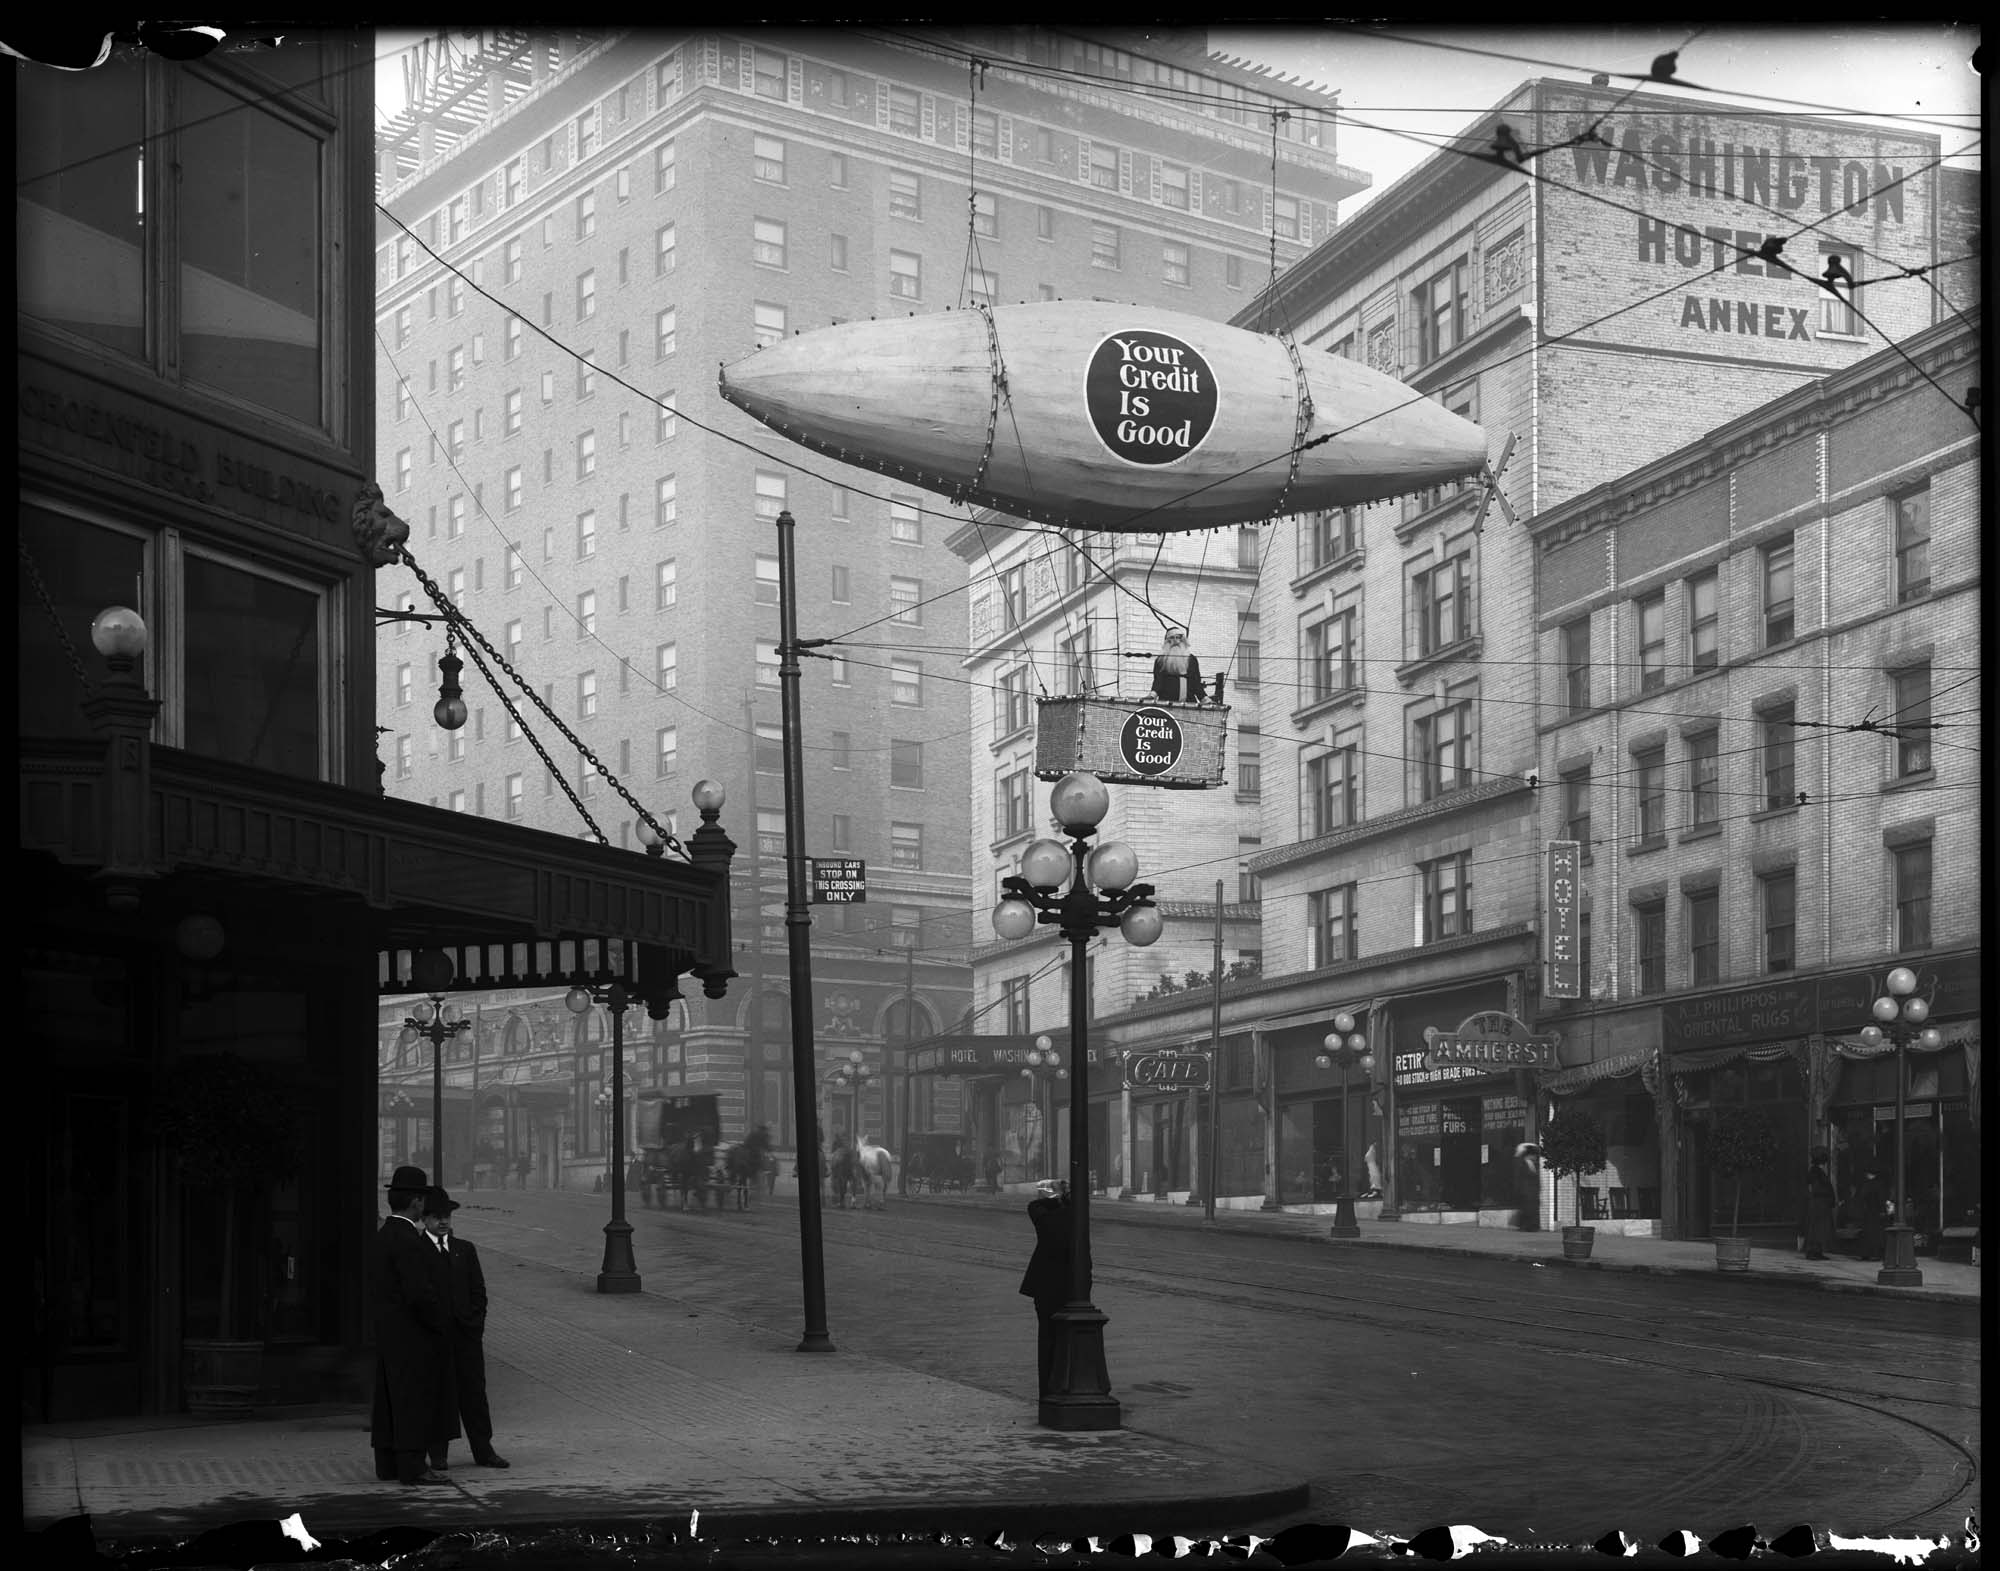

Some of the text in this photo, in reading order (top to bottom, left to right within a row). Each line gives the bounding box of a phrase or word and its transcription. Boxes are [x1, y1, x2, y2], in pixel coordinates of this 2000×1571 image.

[1568, 121, 1904, 224] WASHINGTON
[1638, 217, 1792, 280] HOTEL
[1680, 295, 1811, 342] ANNEX
[1112, 338, 1184, 366] Your
[1119, 364, 1200, 393] Credit
[1119, 391, 1150, 417] Is
[1117, 420, 1191, 447] Good
[217, 449, 341, 523] BUILDING
[1136, 714, 1167, 726] Your
[1135, 726, 1173, 740] Credit
[1136, 738, 1151, 750] Is
[1135, 751, 1172, 765] Good
[820, 870, 858, 879] STOP ON
[844, 861, 861, 869] CARS
[815, 880, 865, 890] THIS CROSSING
[826, 891, 855, 901] ONLY
[1554, 850, 1573, 989] HOTEL
[1473, 1016, 1513, 1036] THE
[1751, 1008, 1790, 1030] RUGS
[951, 1050, 977, 1063] HOTEL
[1437, 1040, 1553, 1063] AMHERST
[1443, 1067, 1461, 1080] GRADE
[1443, 1121, 1466, 1133] FURS
